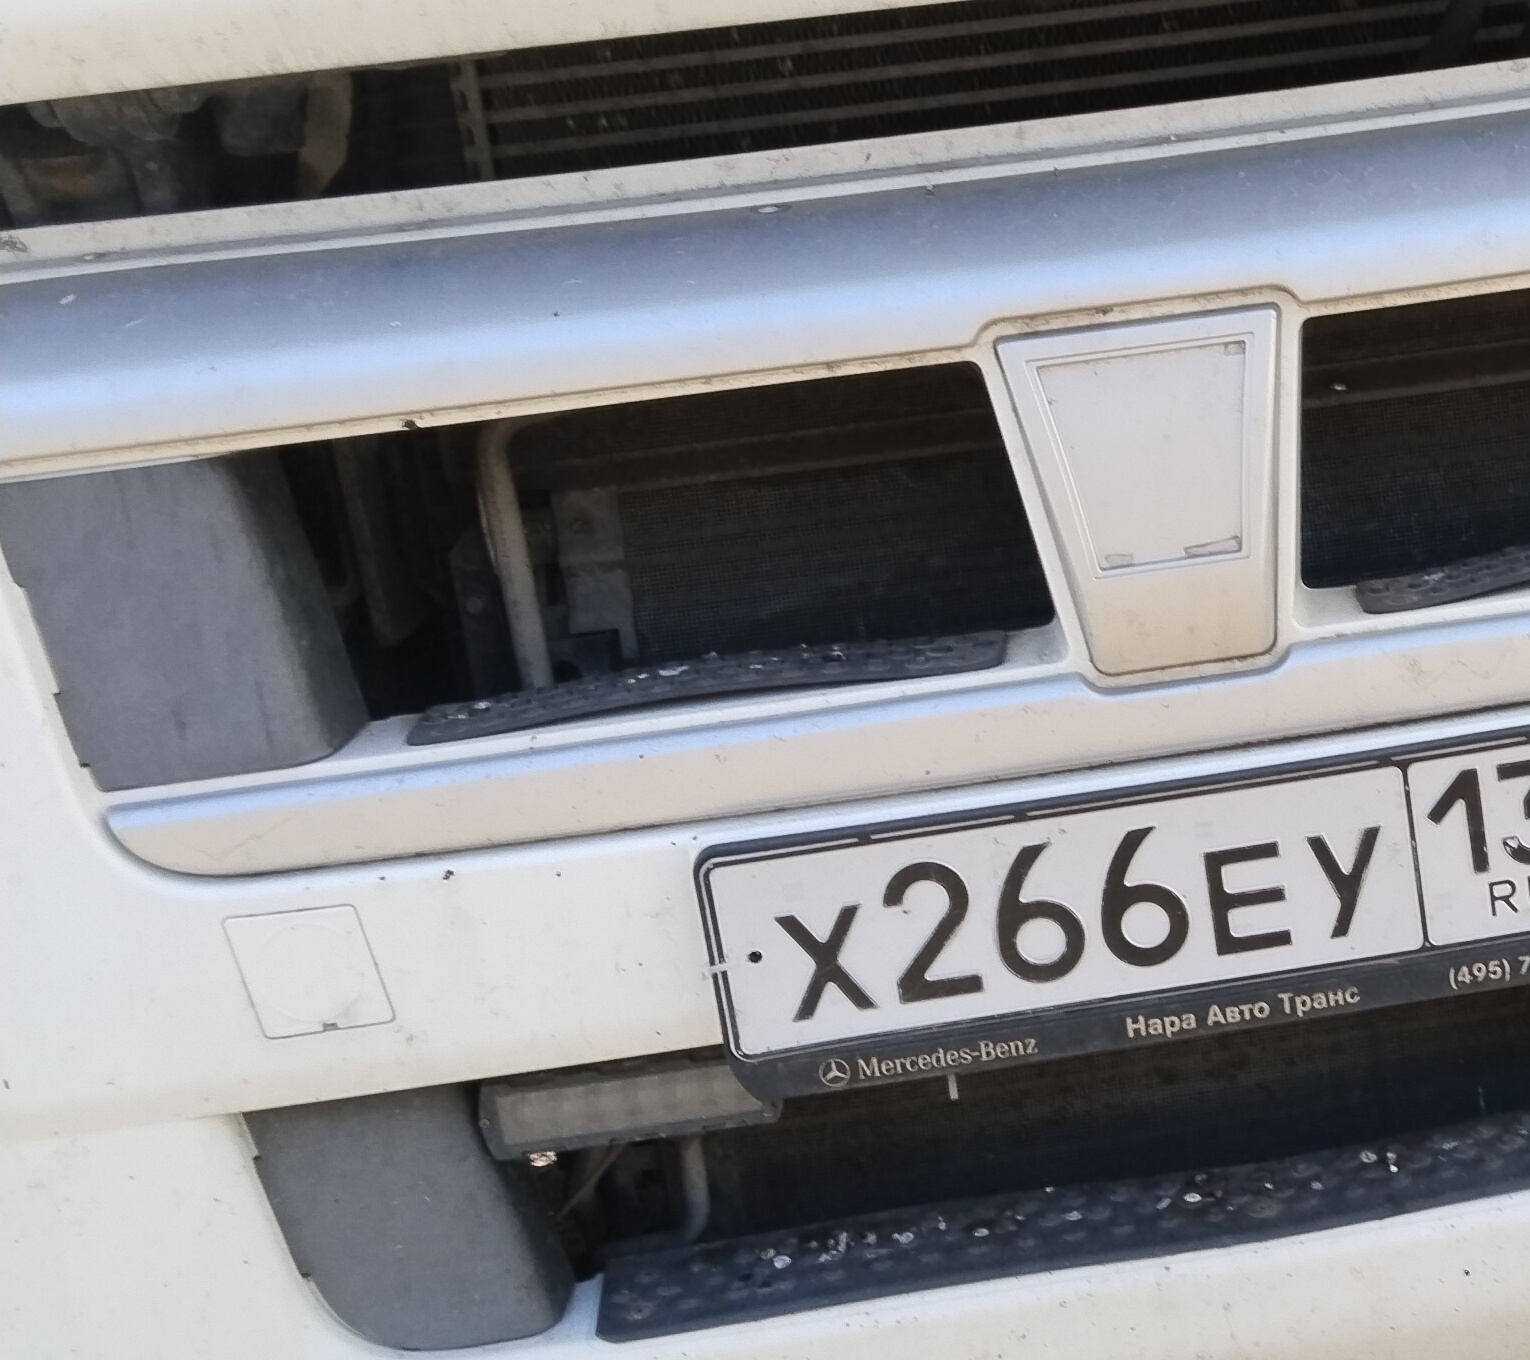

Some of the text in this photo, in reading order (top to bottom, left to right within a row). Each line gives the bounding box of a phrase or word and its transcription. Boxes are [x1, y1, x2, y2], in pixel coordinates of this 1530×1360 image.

[774, 824, 1383, 1024] Х266ЕУ
[1448, 957, 1512, 990] (495)
[1124, 985, 1362, 1039] Нара Авто Транс
[856, 1037, 1040, 1081] Mercedes-Benz
